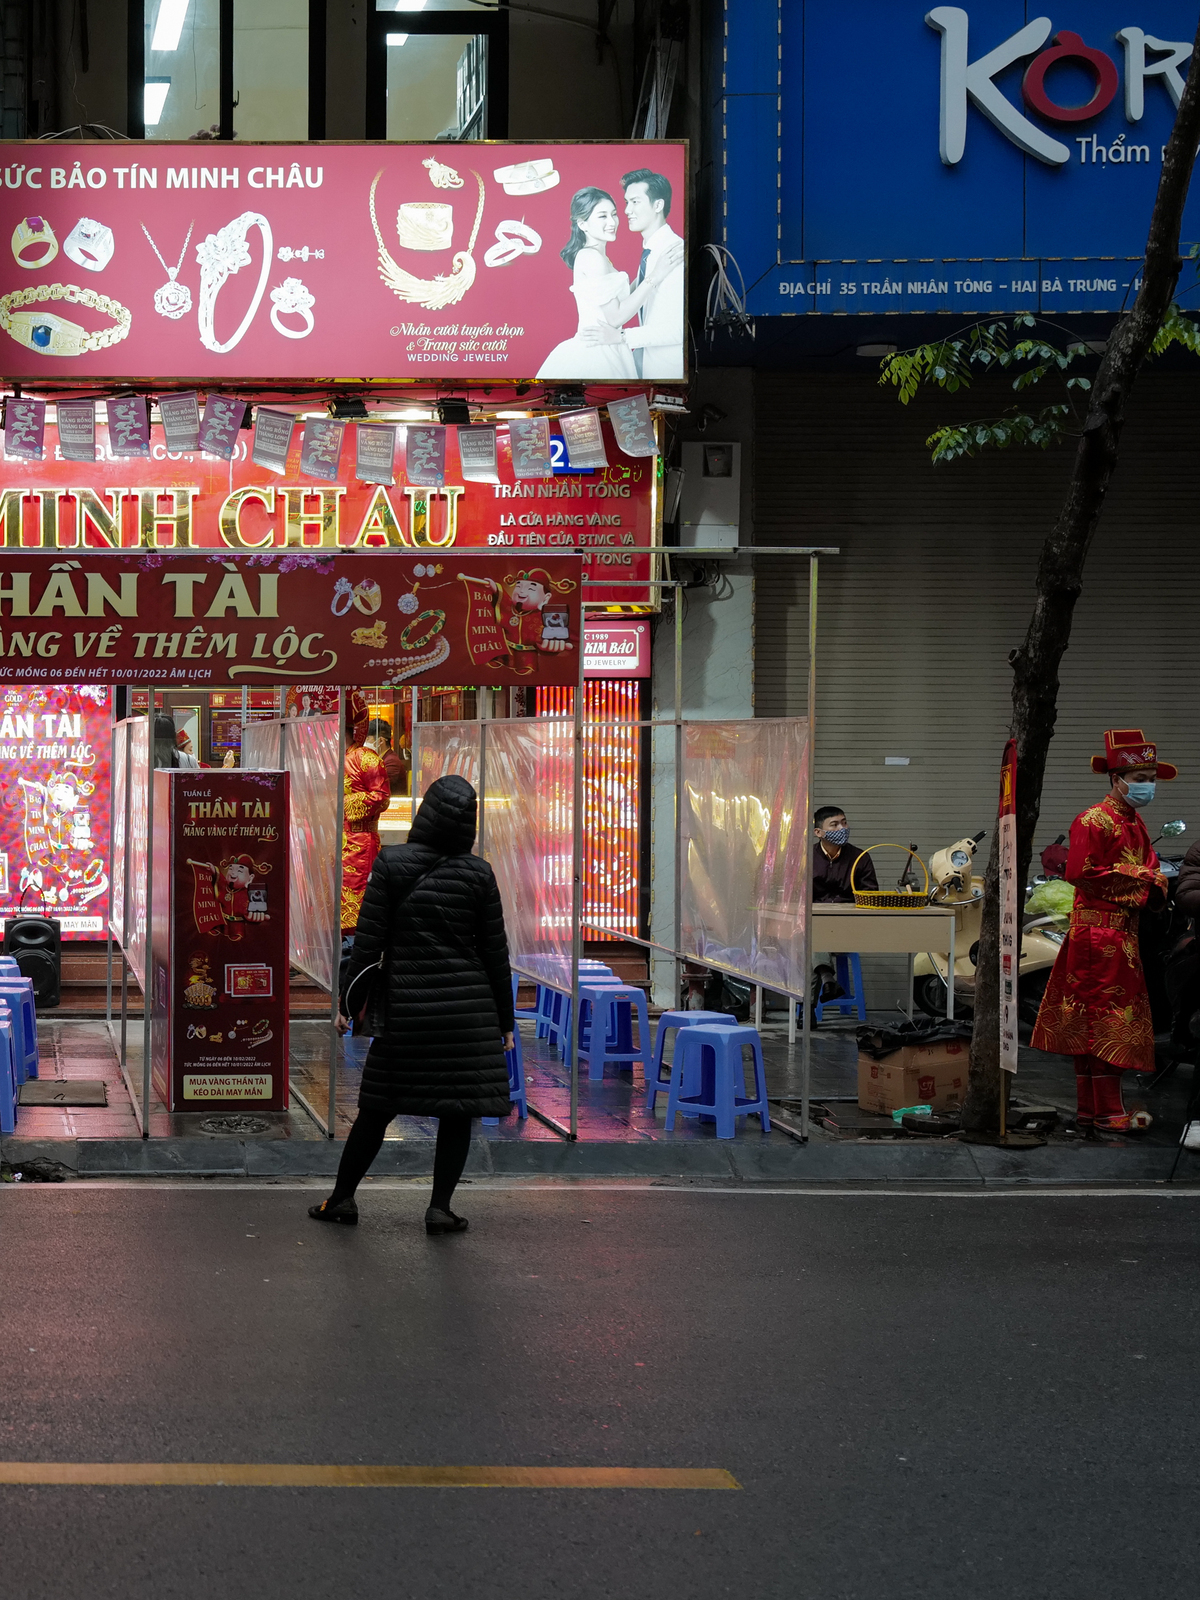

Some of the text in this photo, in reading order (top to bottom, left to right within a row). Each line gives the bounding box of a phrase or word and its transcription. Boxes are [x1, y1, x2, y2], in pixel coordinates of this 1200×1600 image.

[1076, 133, 1150, 169] Thẩm
[51, 161, 107, 189] BẢO
[113, 163, 157, 188] TÍN
[165, 167, 240, 189] MINH
[247, 163, 323, 188] CHÂU
[779, 276, 1117, 298] ĐỊA CHỈ 35 TRẦN NHÂN TÔNG HAI BÀ TRƯNG
[407, 353, 509, 362] WEDDING JEWELRY
[492, 480, 631, 498] TRẦN NHÂN TÔNG
[499, 510, 621, 527] LÀ CỬA HÀNG VÀNG
[486, 529, 635, 546] ĐẦU TIÊN CỦA BTMC VÀ
[161, 562, 280, 618] TÀI
[73, 624, 123, 658] VỀ
[132, 626, 237, 658] THÊM
[251, 626, 325, 665] LỘC
[50, 668, 62, 677] 06
[64, 665, 86, 677] ĐẾN
[88, 665, 109, 677] HẾT
[111, 668, 168, 678] 10/01/2022
[169, 668, 185, 678] ÂM
[188, 669, 212, 680] LỊCH
[41, 709, 81, 738] TÀI
[188, 796, 270, 818] THẦN TÀI
[208, 1076, 231, 1086] VÀNG
[232, 1076, 253, 1085] THẦN
[254, 1076, 267, 1086] TÀI
